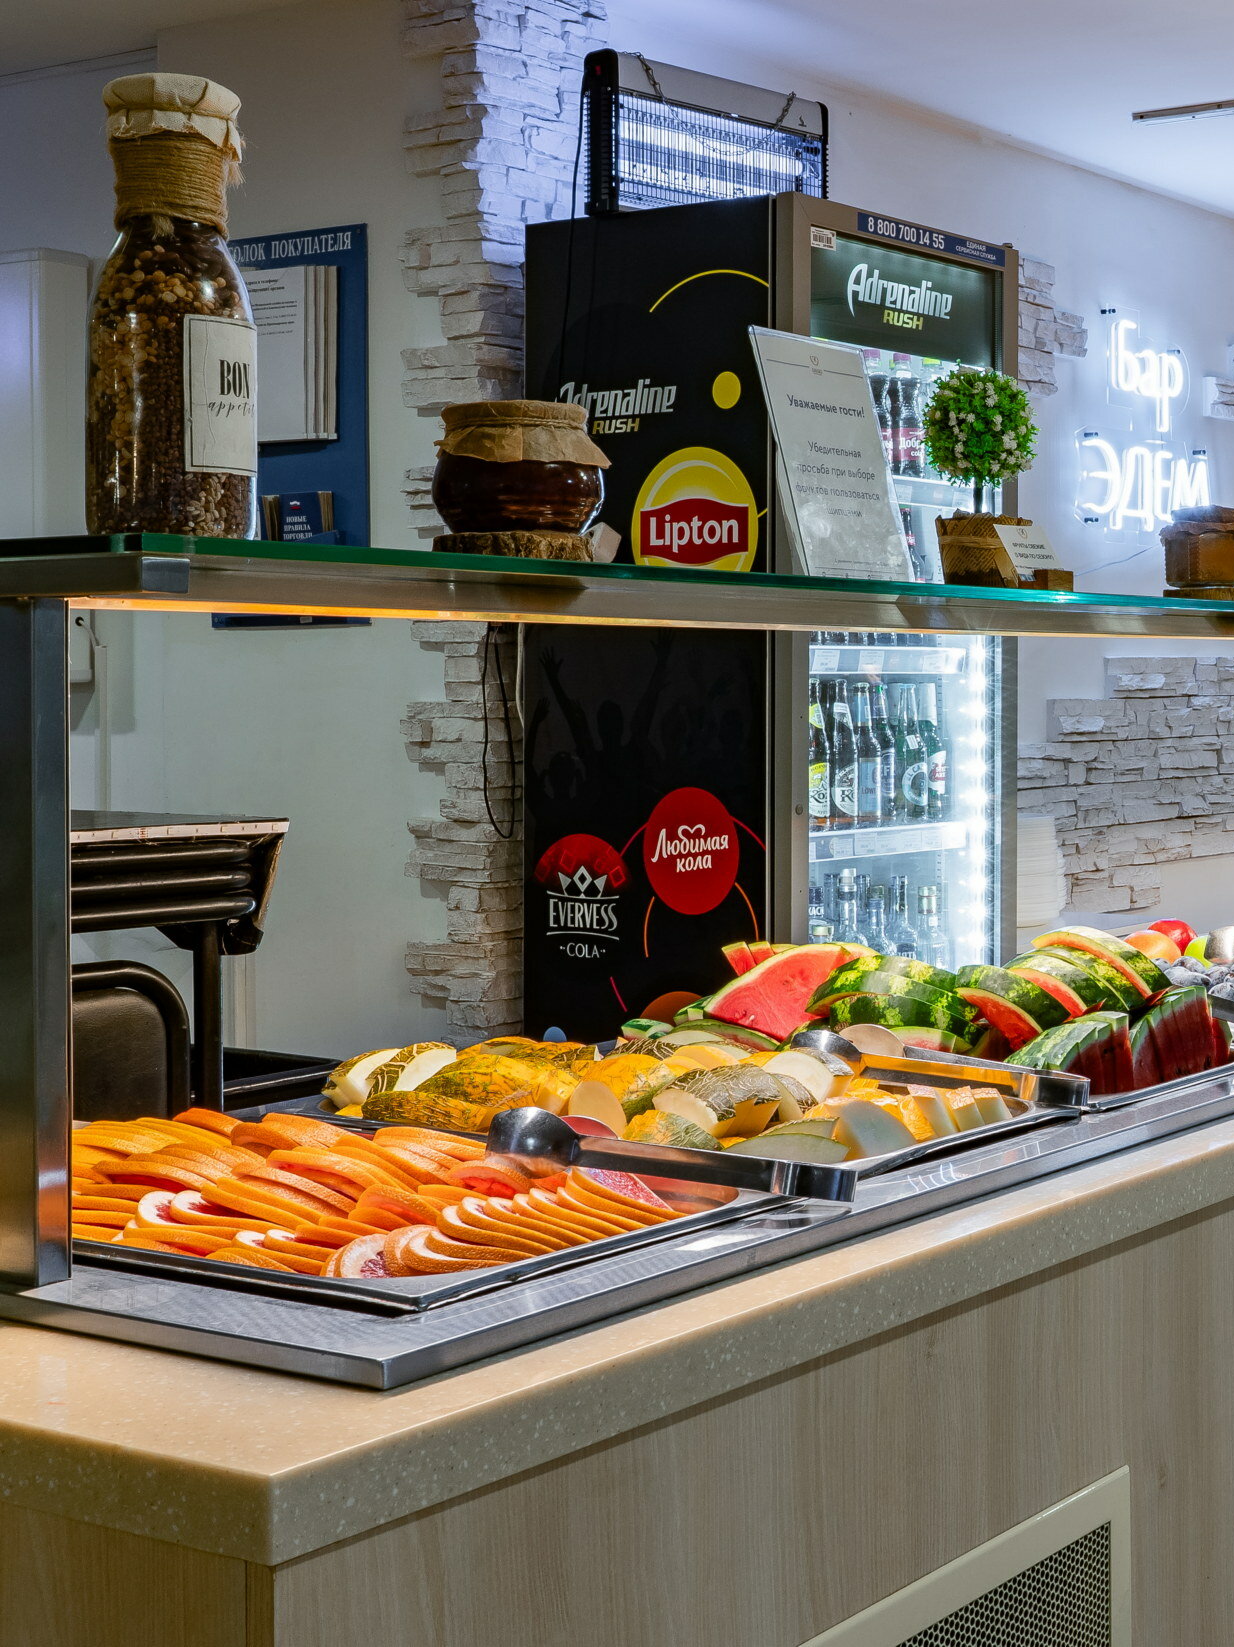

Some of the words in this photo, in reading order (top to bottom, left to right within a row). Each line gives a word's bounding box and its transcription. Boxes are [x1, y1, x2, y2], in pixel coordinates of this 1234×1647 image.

[270, 231, 352, 259] ПОКУПАТЕЛЯ
[868, 217, 875, 232] 8
[877, 219, 896, 237] 800
[898, 224, 917, 242] 700
[919, 229, 930, 246] 14
[932, 233, 946, 250] 55
[847, 263, 953, 320] Adrenaline
[883, 309, 924, 330] RUSH
[219, 359, 250, 399] BON
[555, 378, 677, 418] Adrenaline
[786, 393, 838, 414] Уважаемые
[838, 406, 865, 418] гости!
[592, 417, 640, 435] RUSH
[807, 440, 862, 458] Убедительная
[831, 467, 847, 478] при
[847, 468, 876, 482] выборе
[829, 487, 881, 501] пользоваться
[283, 524, 311, 532] ПРАВИЛА
[286, 515, 307, 523] НОВЫЕ
[649, 514, 739, 553] Lipton
[651, 823, 730, 863] Любимая
[676, 854, 713, 873] кола
[549, 898, 619, 932] EVERVESS
[566, 942, 600, 959] COLA
